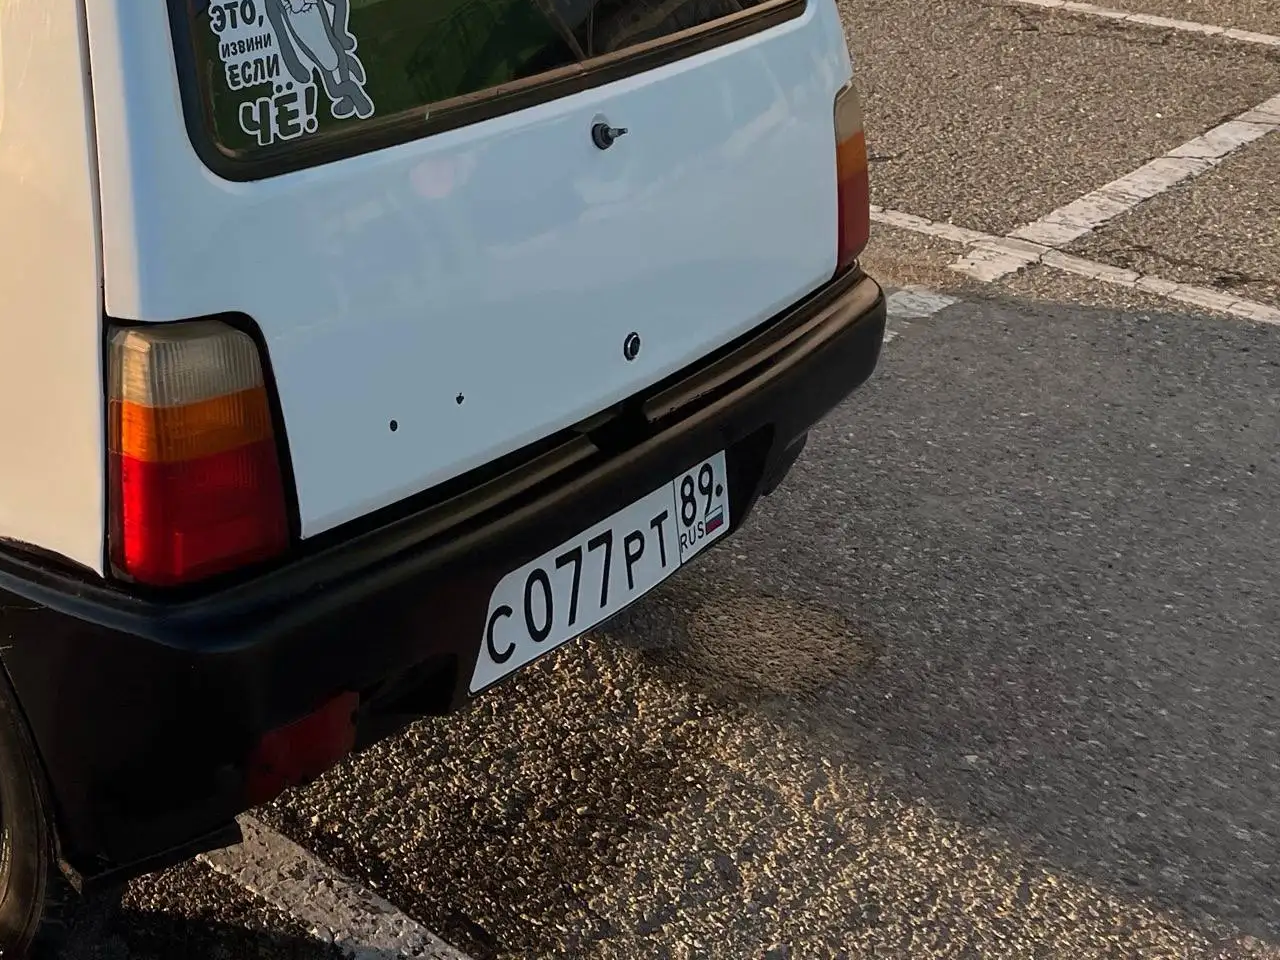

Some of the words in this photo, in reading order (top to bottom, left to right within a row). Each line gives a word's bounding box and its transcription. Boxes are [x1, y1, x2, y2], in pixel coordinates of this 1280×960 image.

[221, 33, 272, 58] ИЗВИНИ
[227, 53, 281, 87] ЕСЛИ
[241, 81, 317, 144] ЧЁ!
[680, 461, 714, 528] 89
[679, 519, 705, 554] RUS
